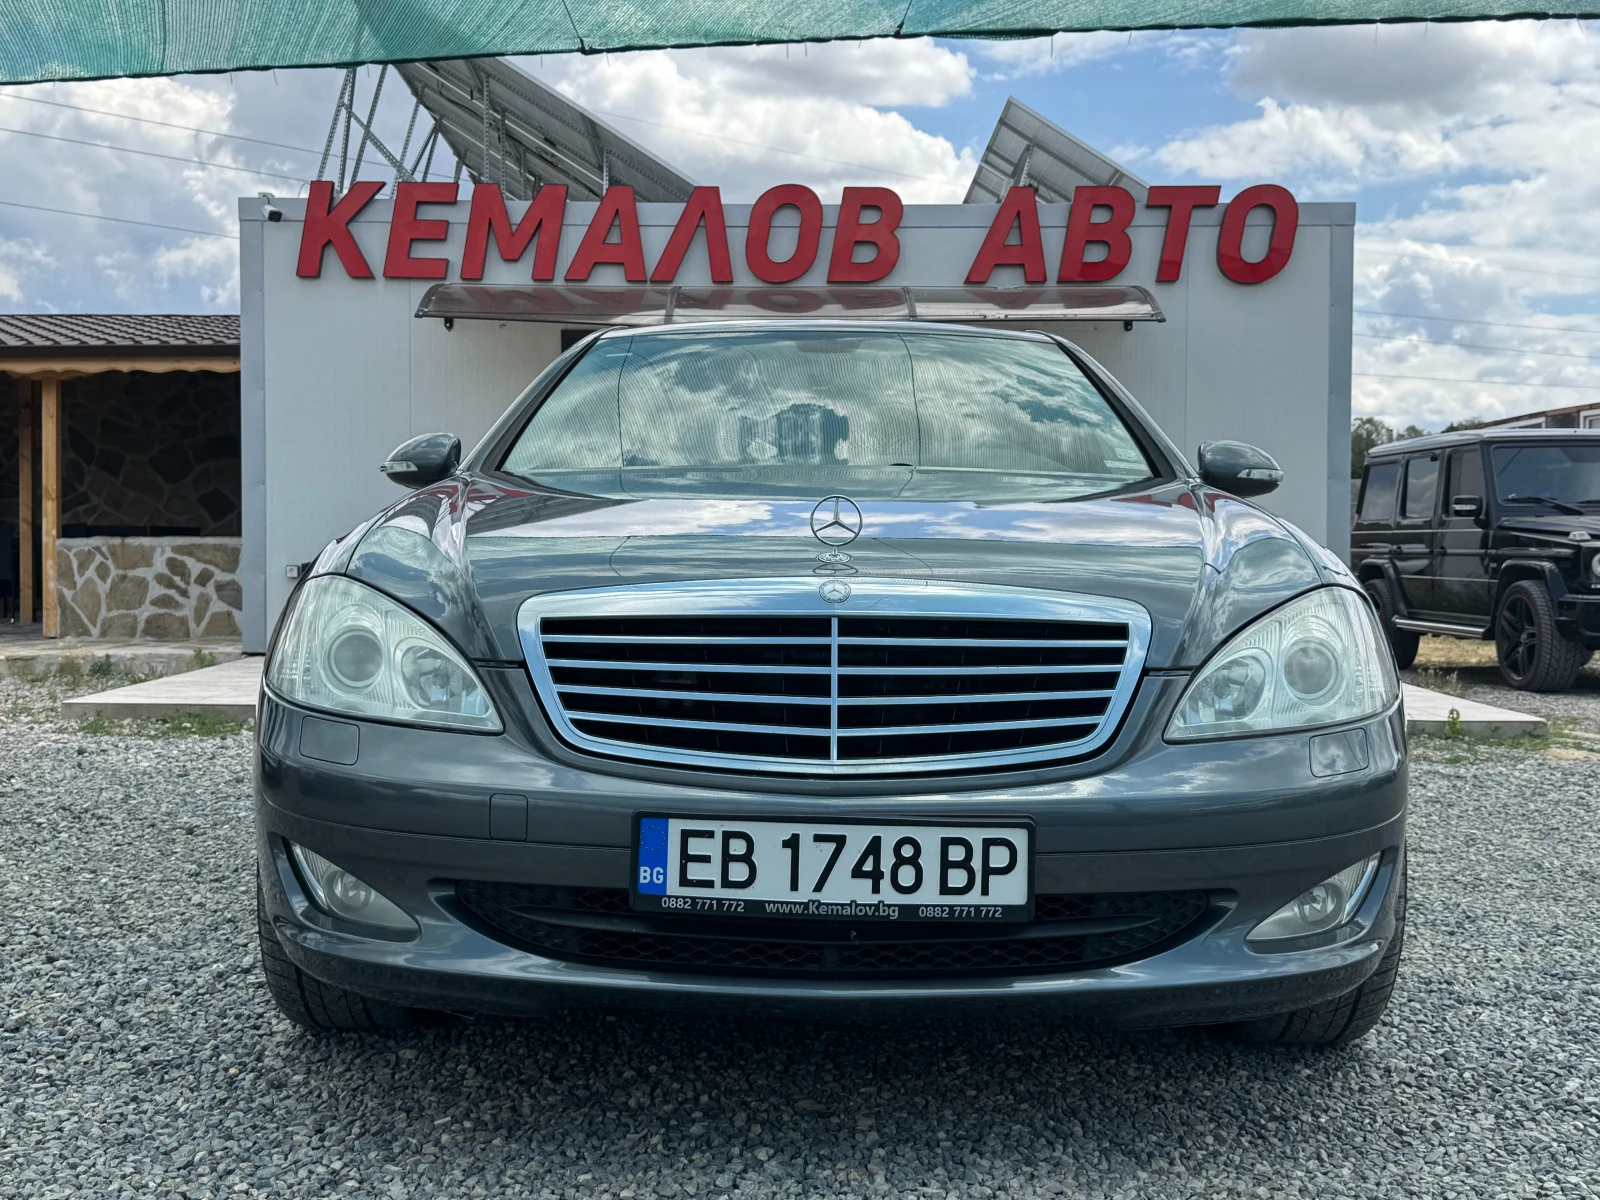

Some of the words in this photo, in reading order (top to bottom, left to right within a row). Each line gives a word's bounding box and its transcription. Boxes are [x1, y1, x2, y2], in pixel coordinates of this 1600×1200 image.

[297, 180, 904, 284] КЕМАЛОВ
[965, 184, 1299, 284] АВТО
[679, 828, 757, 889] EB
[781, 833, 923, 895] 1748
[939, 837, 1017, 896] BP
[639, 866, 664, 884] BG
[661, 897, 692, 910] 0882
[695, 899, 717, 911] 771
[722, 900, 745, 912] 772
[765, 901, 899, 920] www.Kemalov.bg
[919, 906, 949, 918] 0882
[953, 907, 974, 919] 771
[979, 907, 1003, 919] 772
